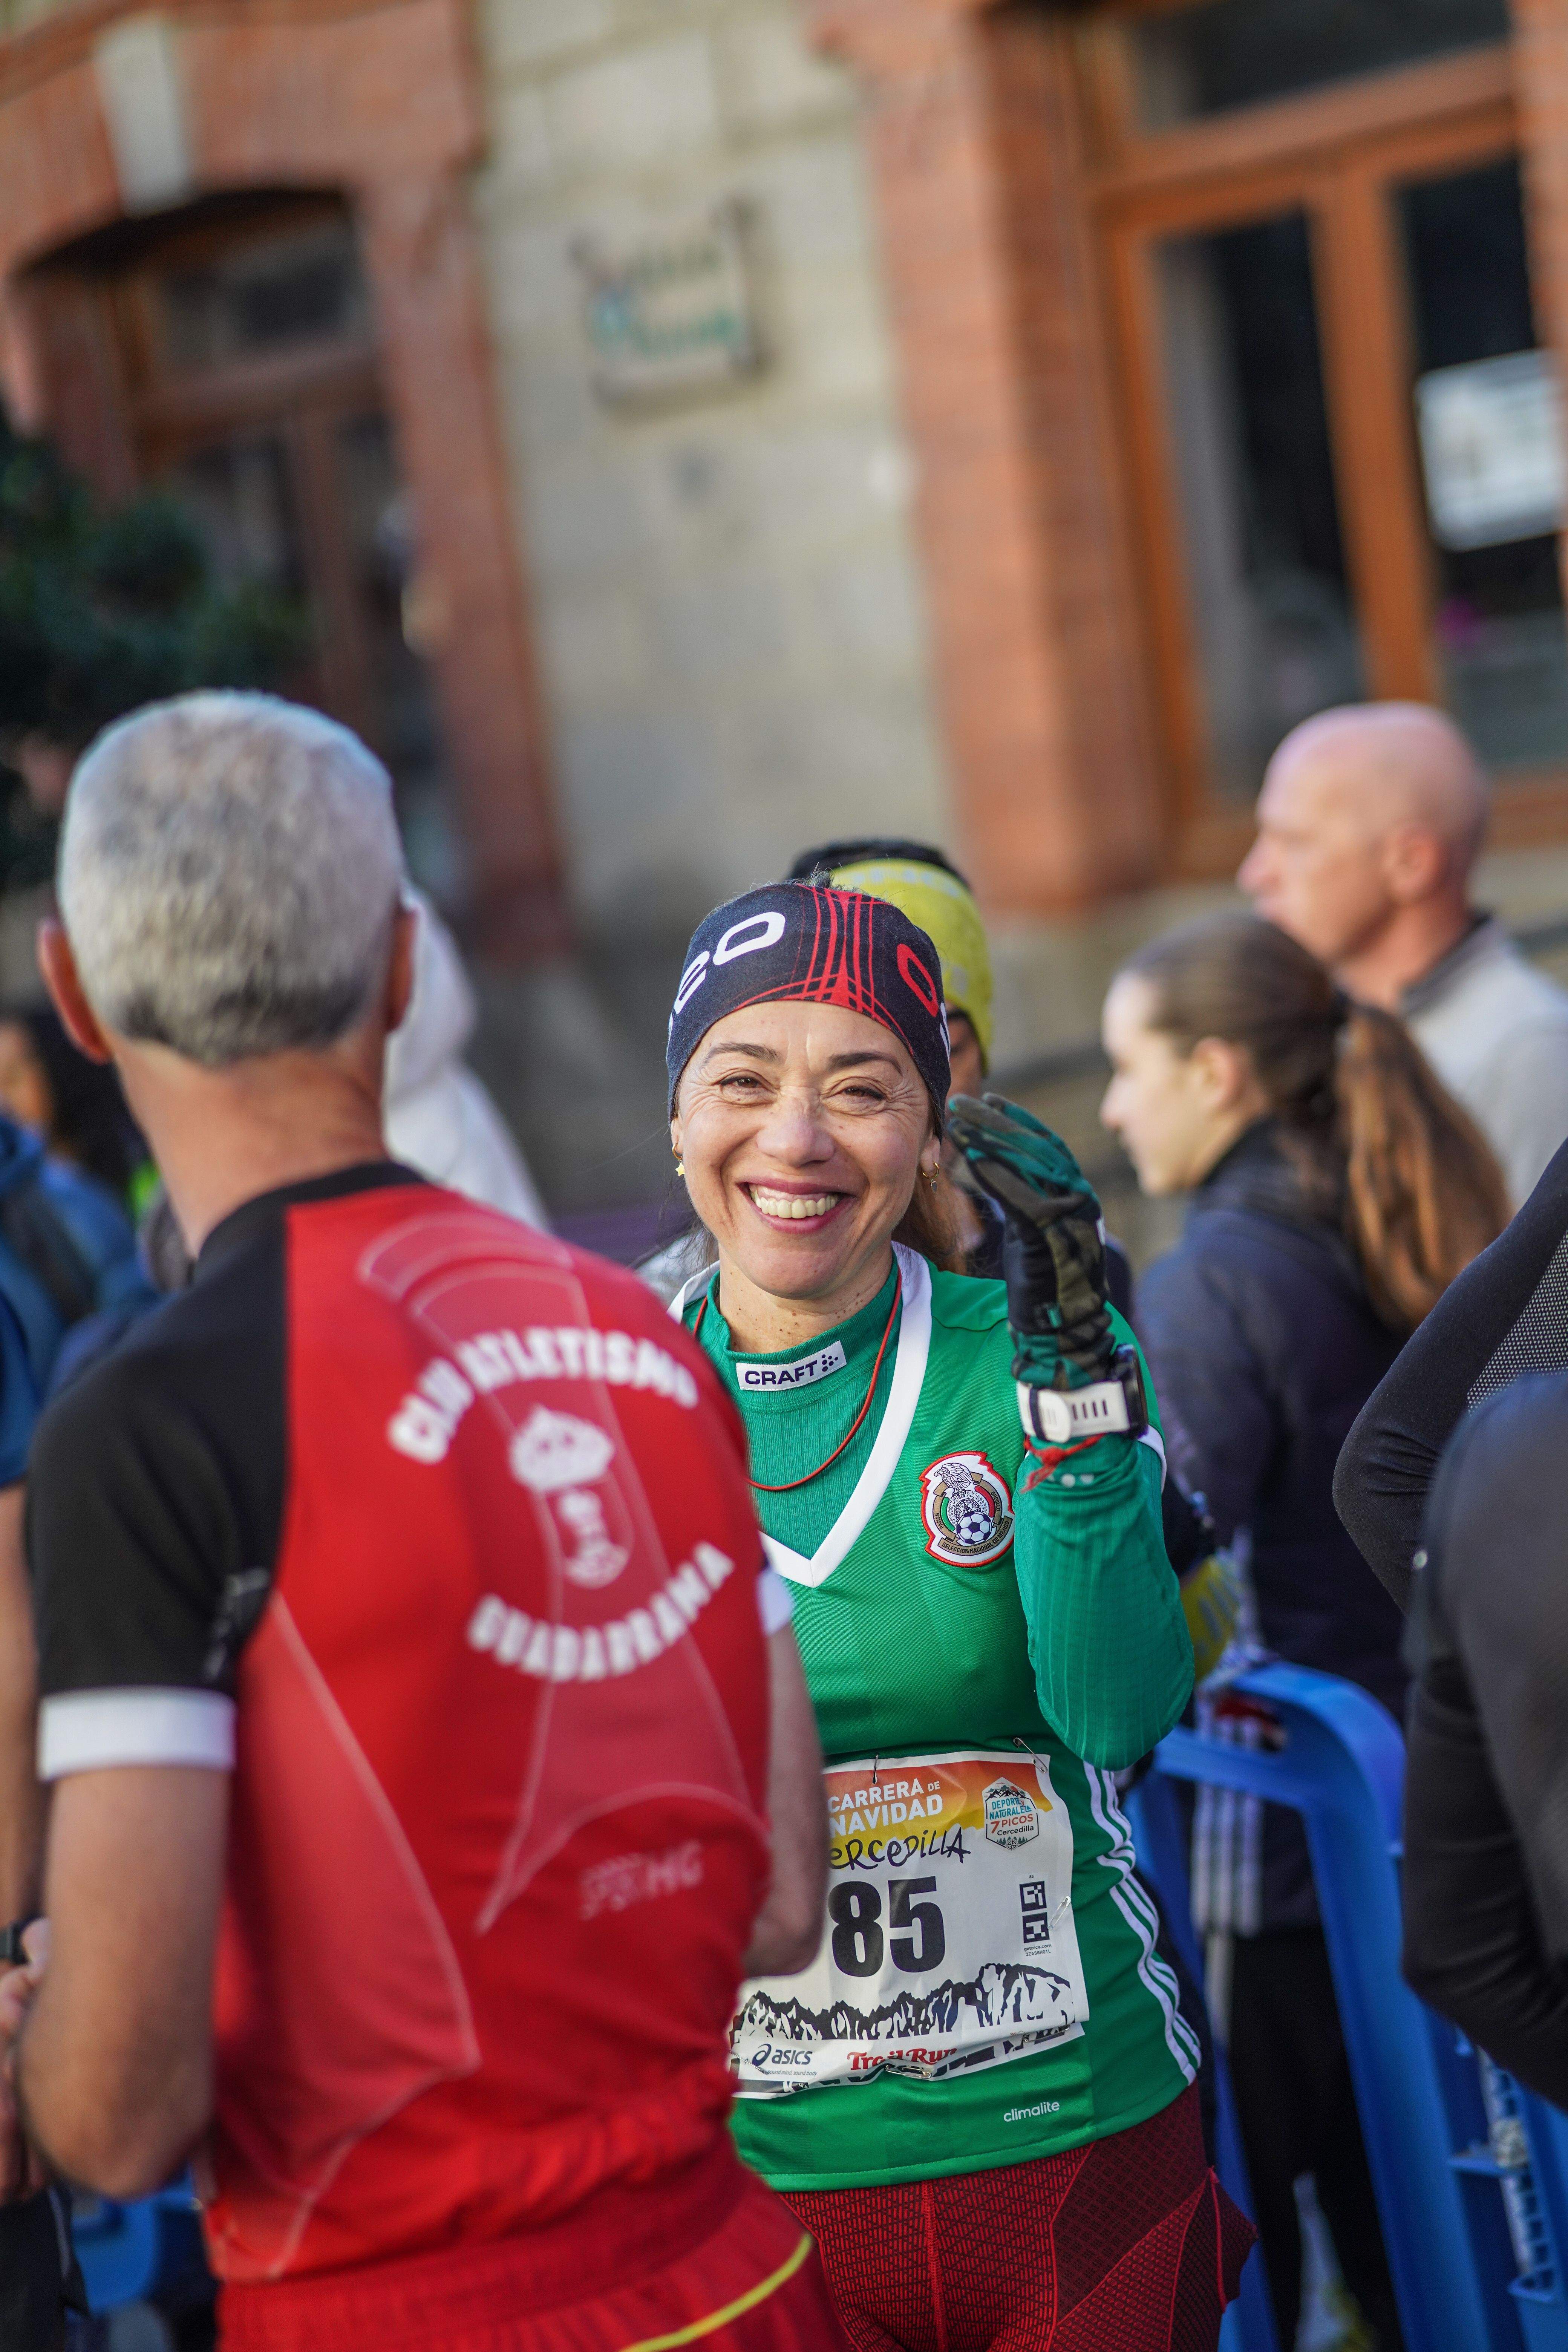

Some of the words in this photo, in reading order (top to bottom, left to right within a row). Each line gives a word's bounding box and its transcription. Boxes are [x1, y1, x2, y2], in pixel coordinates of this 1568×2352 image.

[744, 1359, 818, 1385] CRAFT
[991, 1491, 1001, 1511] ORGULLO
[935, 1513, 944, 1529] PASIÓN
[942, 1542, 969, 1554] SELECCIÓN
[969, 1542, 994, 1554] NACIONAL
[828, 1778, 924, 1814] CARRERA
[928, 1781, 941, 1792] DE
[992, 1798, 1021, 1810] DEPORTE
[828, 1794, 943, 1837] NAVIDAD
[989, 1805, 1032, 1820] NATURALEZA
[990, 1821, 1000, 1834] 7
[1001, 1814, 1034, 1828] PICOS
[997, 1825, 1034, 1836] Cercedilla
[828, 1875, 945, 1977] 85
[1024, 1943, 1052, 1952] getpica.com
[1003, 2101, 1060, 2122] climalite
